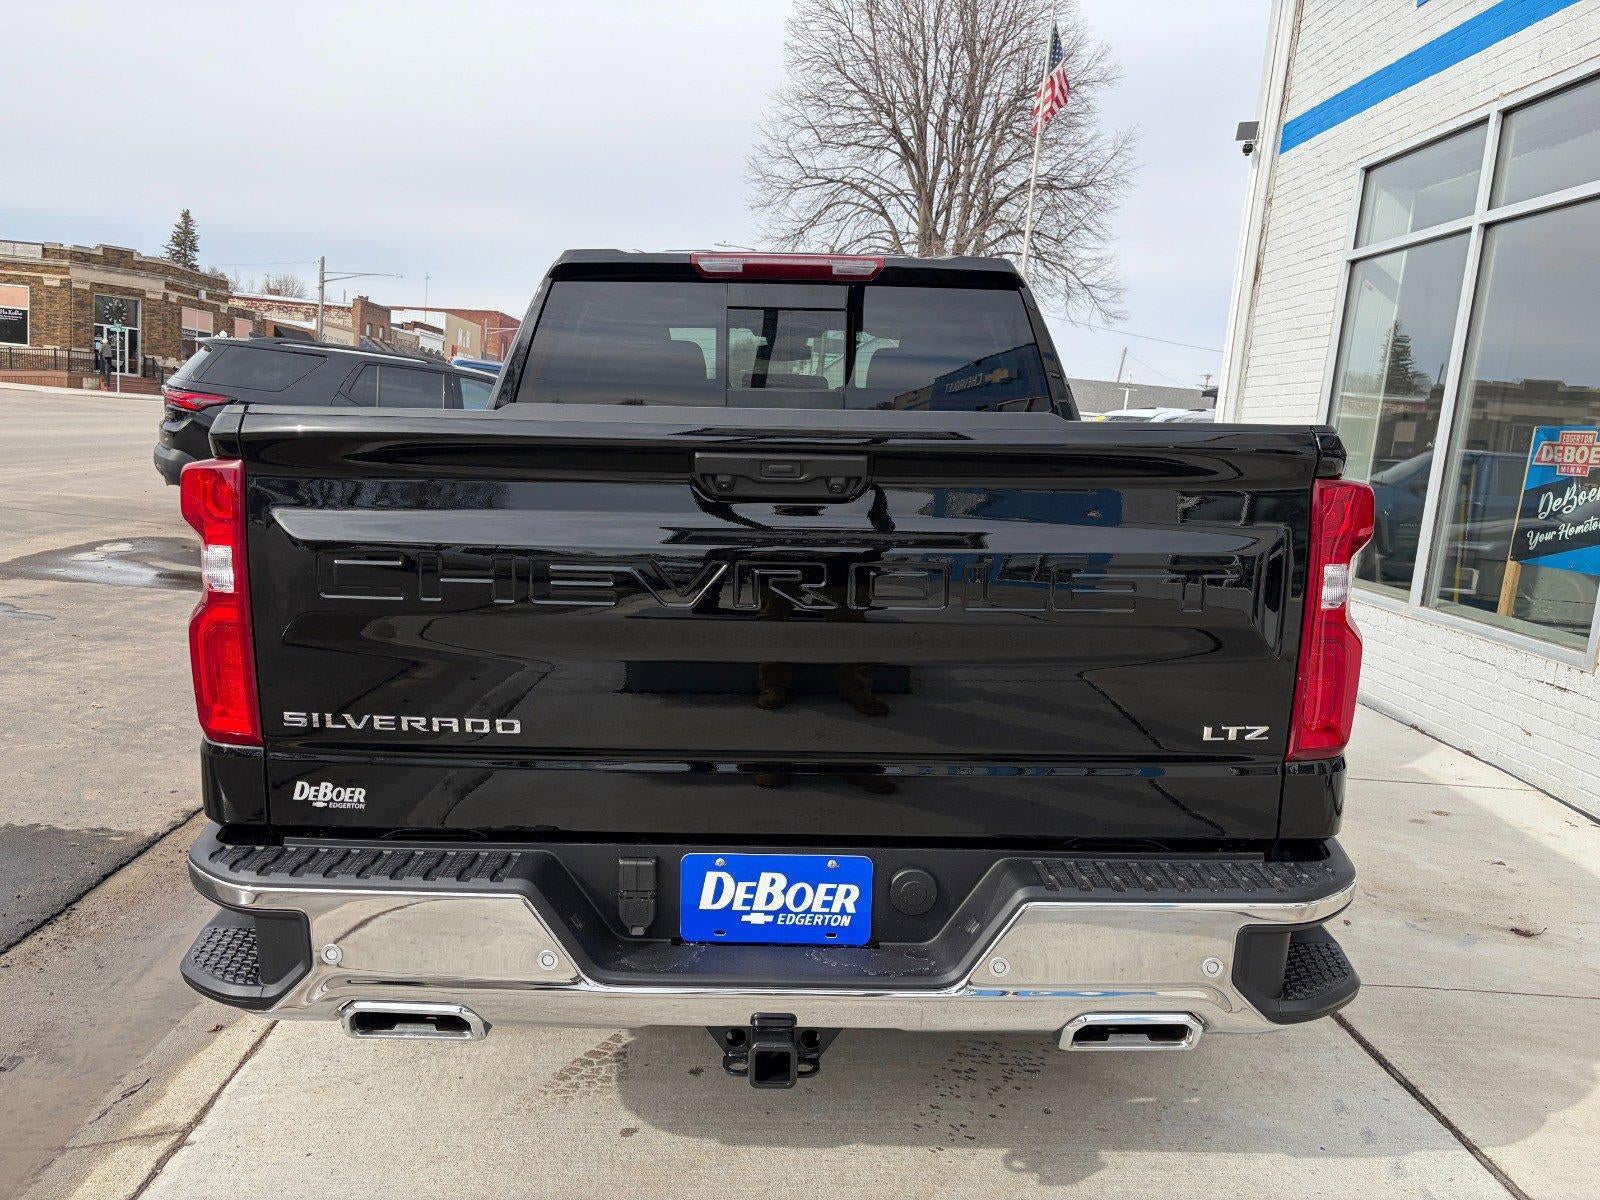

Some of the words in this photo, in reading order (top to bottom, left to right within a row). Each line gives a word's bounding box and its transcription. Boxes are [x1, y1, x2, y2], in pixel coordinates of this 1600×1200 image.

[1562, 433, 1595, 444] EDGERTON
[1541, 445, 1600, 464] DEBOE
[1560, 465, 1586, 475] MINN.
[1526, 530, 1557, 551] Your
[1557, 515, 1600, 541] Hometo
[316, 550, 1244, 614] CHEVROLET
[283, 711, 522, 734] SILVERADO
[1202, 725, 1270, 741] LTZ
[328, 801, 366, 810] EDGERTON
[776, 912, 851, 927] EDGERTON
